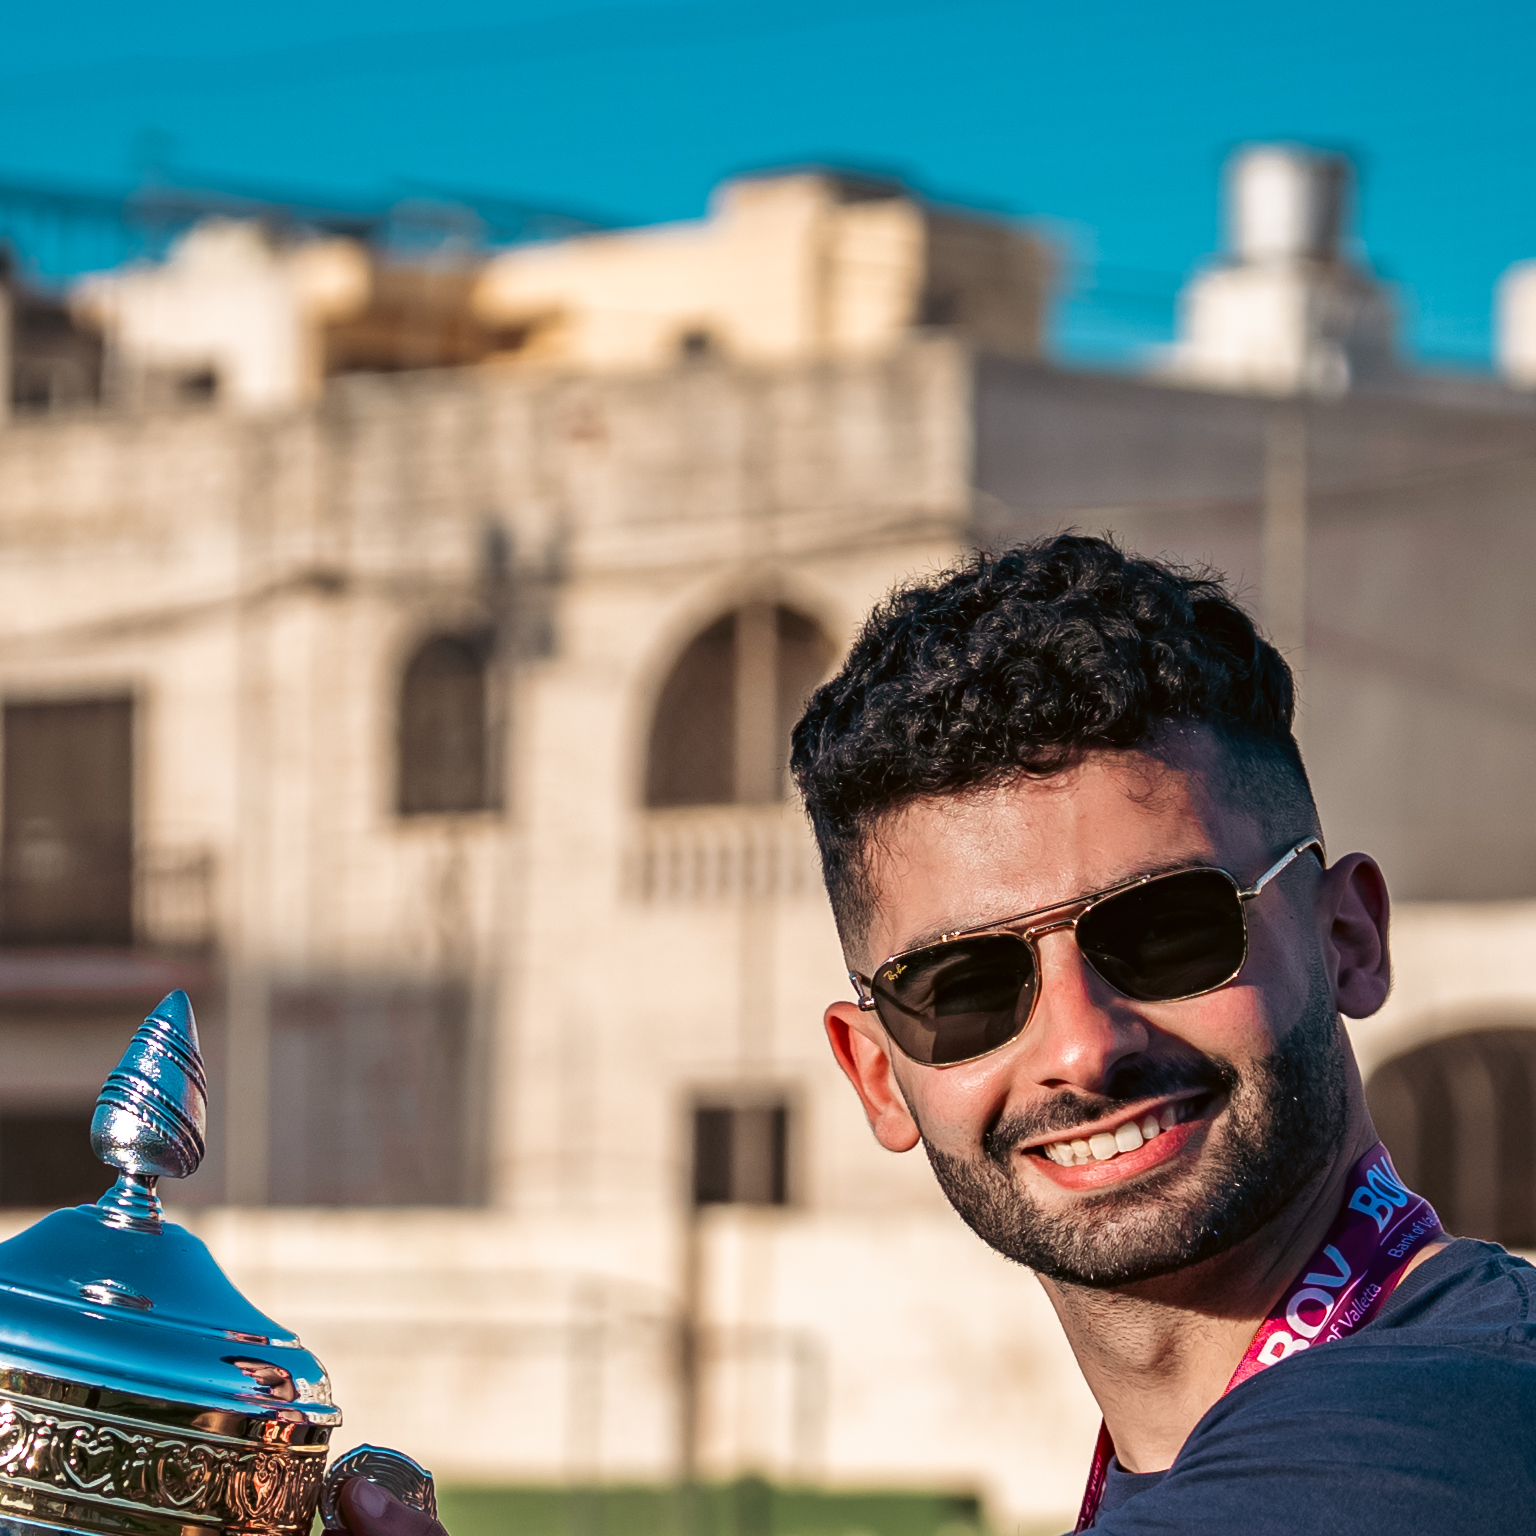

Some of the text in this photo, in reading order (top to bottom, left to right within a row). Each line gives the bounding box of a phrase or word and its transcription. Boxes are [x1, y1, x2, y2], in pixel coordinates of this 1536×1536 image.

[1388, 1233, 1414, 1258] Bank
[1257, 1244, 1352, 1366] BOV
[1338, 1282, 1382, 1328] Valletta
